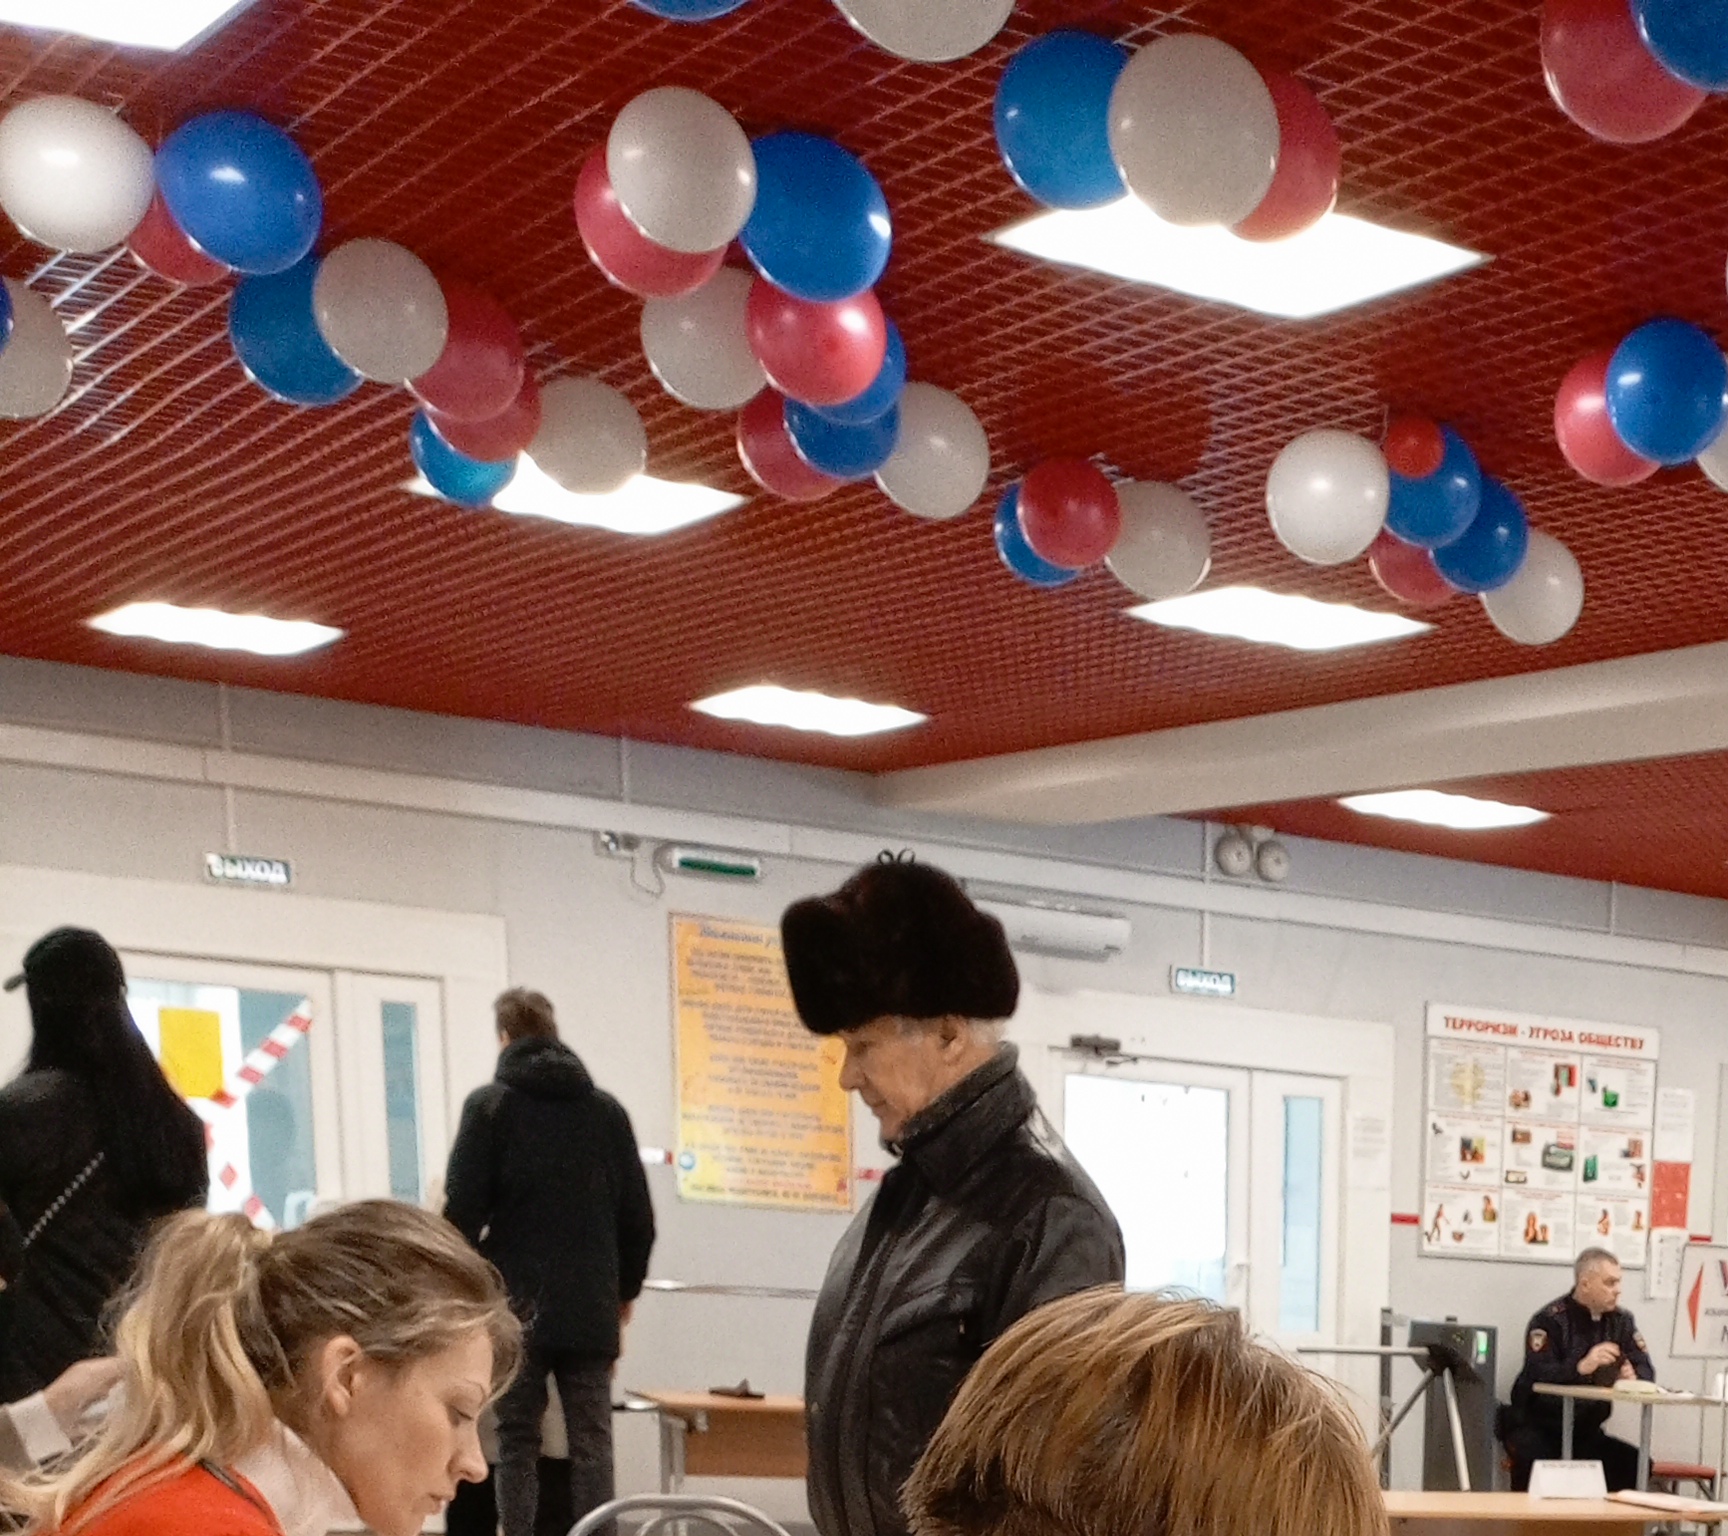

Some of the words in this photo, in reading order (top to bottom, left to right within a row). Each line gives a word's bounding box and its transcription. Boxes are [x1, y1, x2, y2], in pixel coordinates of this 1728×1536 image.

[1444, 1016, 1518, 1036] ТЕРРОРИЗМ
[1528, 1026, 1574, 1044] УГРОЗА
[1579, 1032, 1645, 1051] ОБЩЕСТВУ
